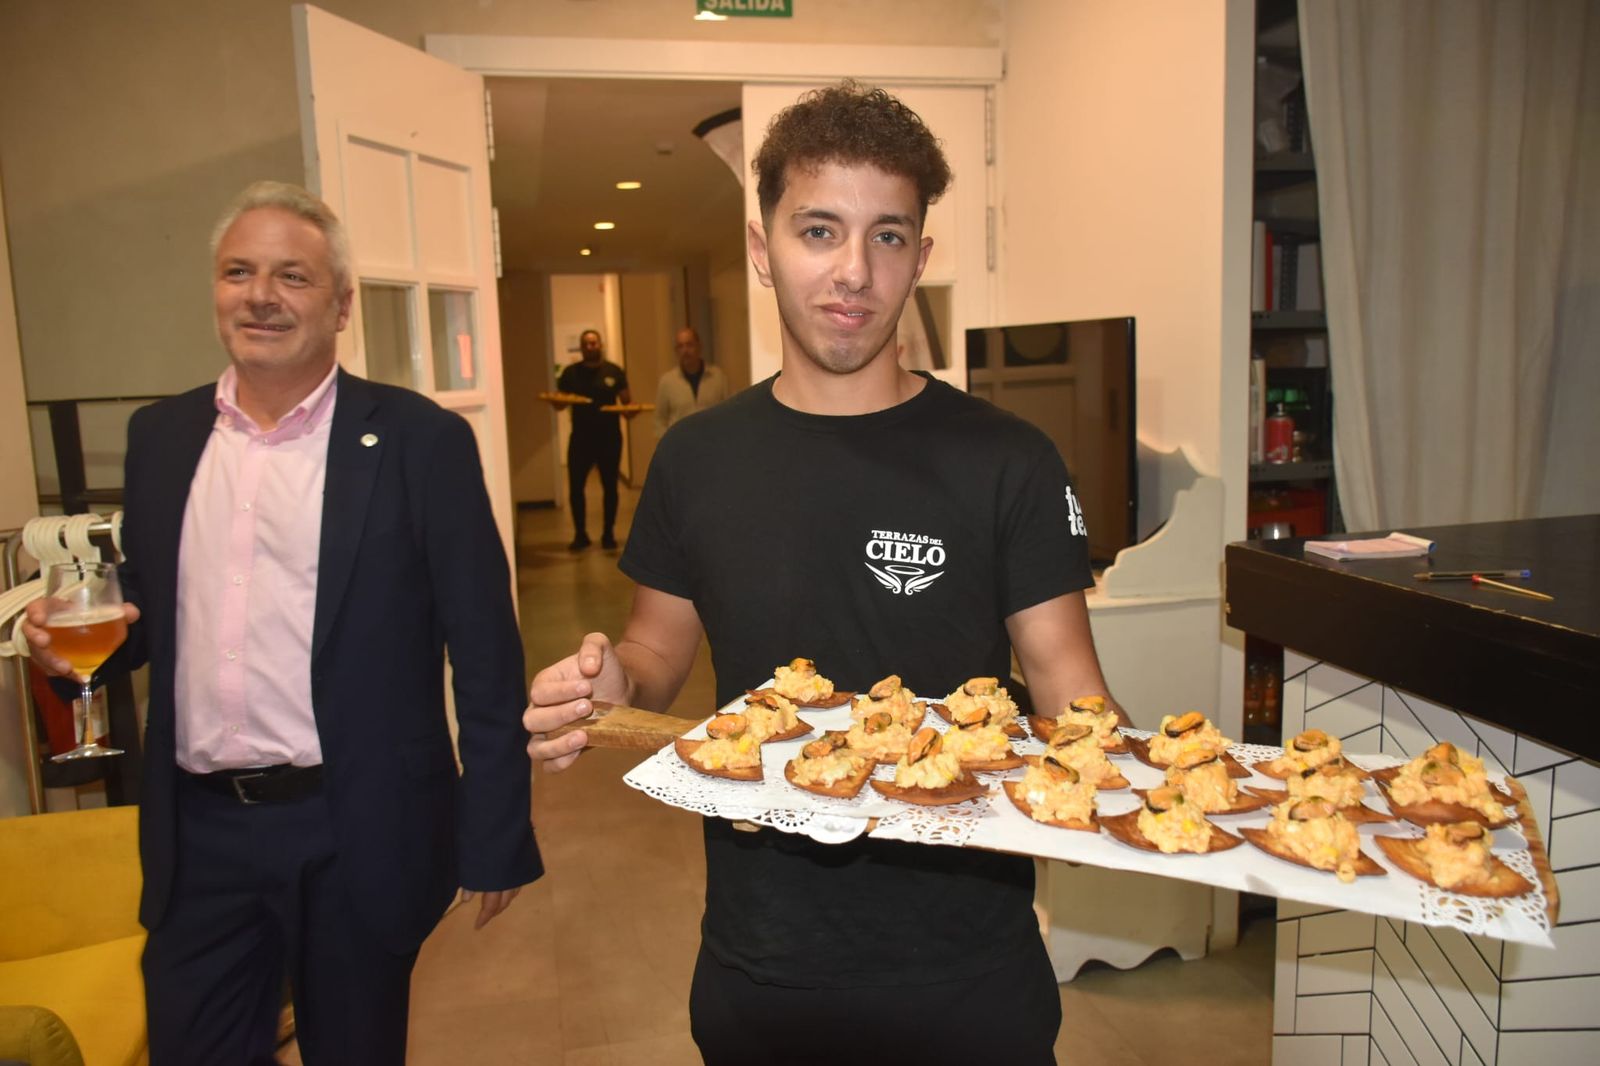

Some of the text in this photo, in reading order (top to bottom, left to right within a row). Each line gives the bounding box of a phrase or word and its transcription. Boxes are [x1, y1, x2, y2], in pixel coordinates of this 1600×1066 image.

[704, 0, 785, 11] SALIDA
[871, 530, 943, 546] TERRAZAS DEL
[865, 539, 946, 566] CIELO
